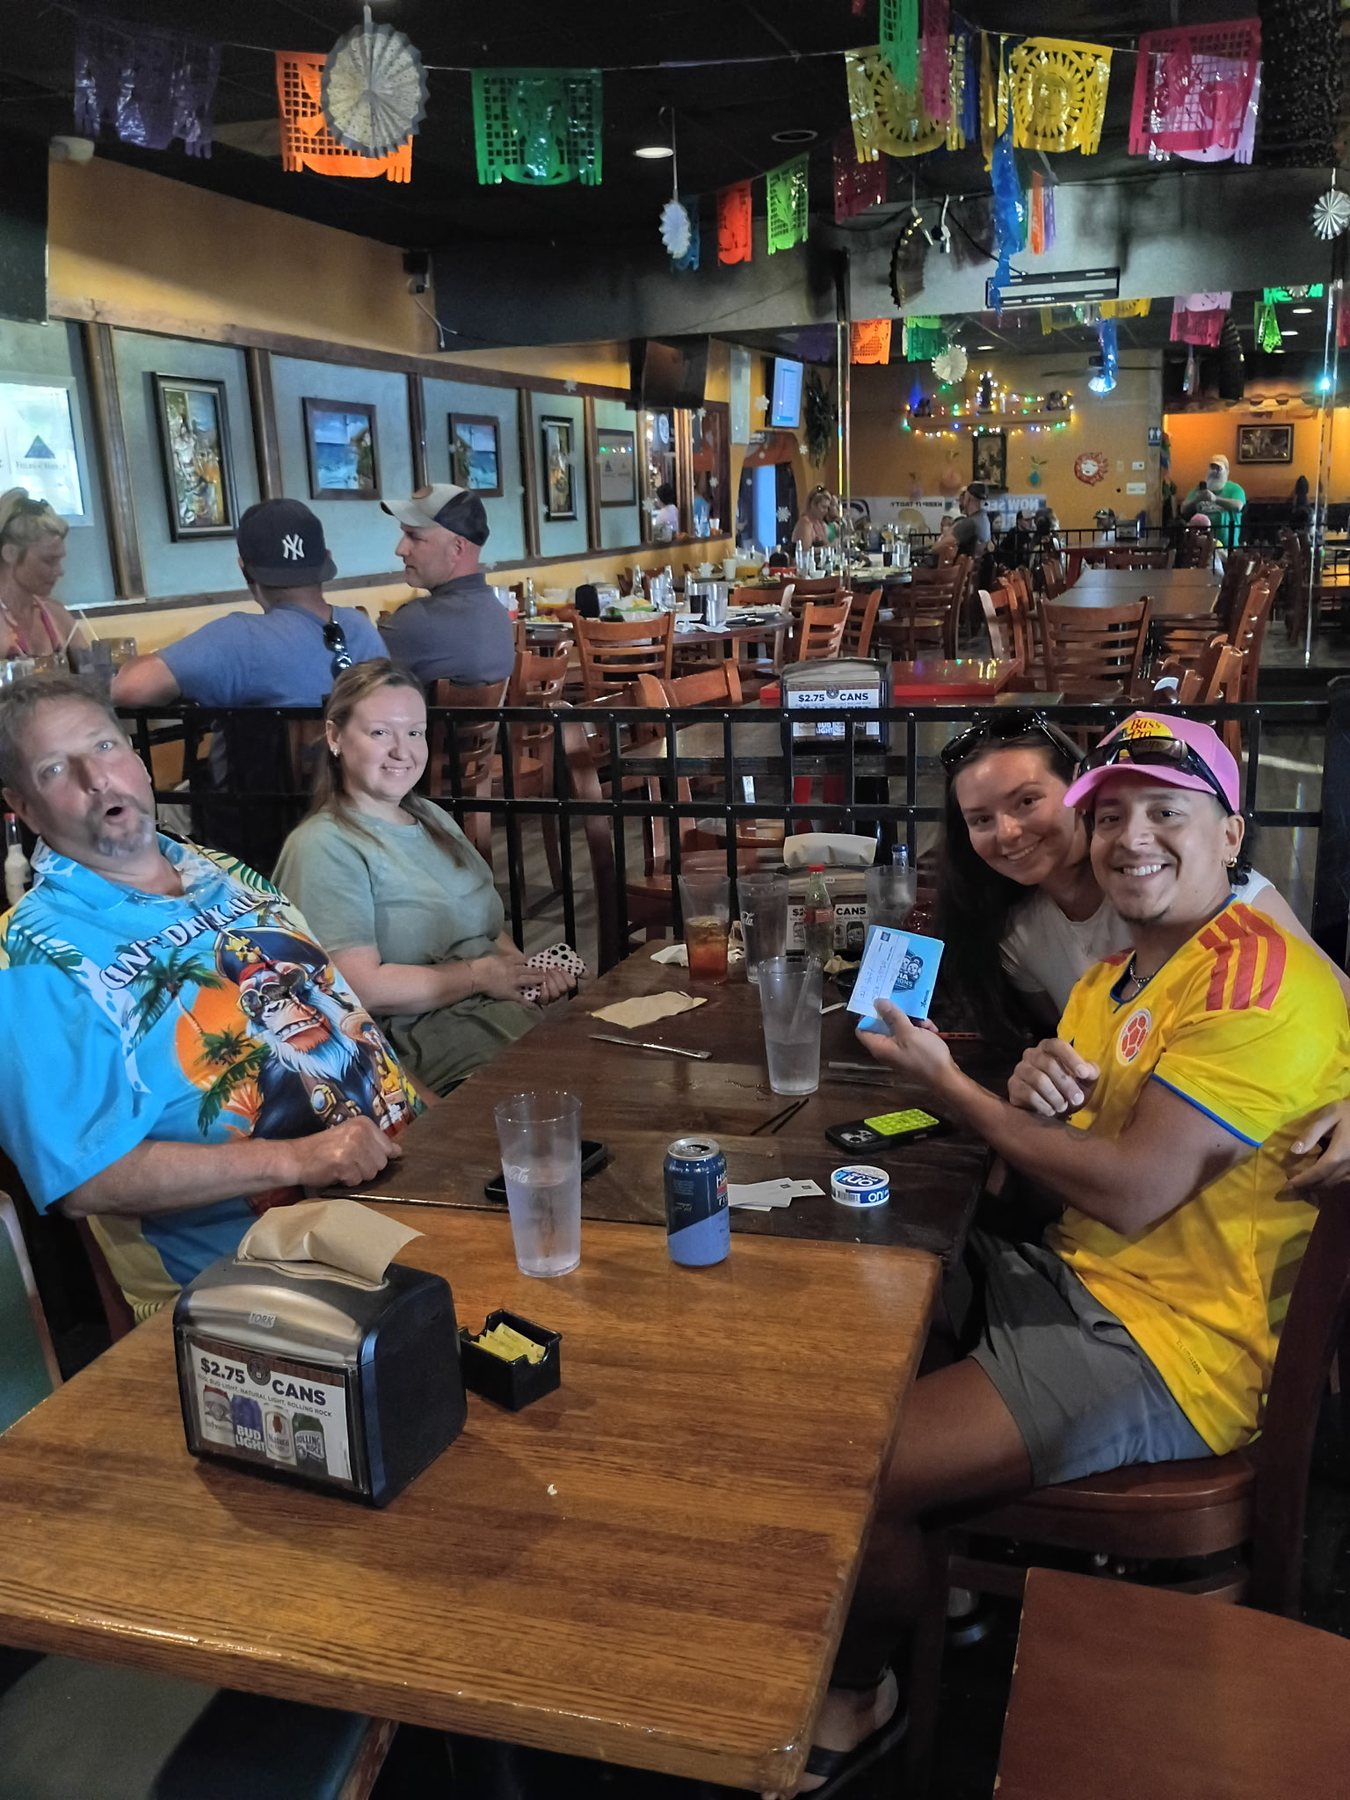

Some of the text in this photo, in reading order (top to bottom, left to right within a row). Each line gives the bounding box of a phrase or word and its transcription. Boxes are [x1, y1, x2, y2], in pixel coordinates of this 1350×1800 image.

[281, 533, 305, 560] NY
[798, 692, 869, 703] $2.75 CANS
[1131, 719, 1161, 730] Bass
[836, 907, 867, 916] CANS
[200, 1357, 327, 1406] $2.75 CANS
[287, 1401, 314, 1413] ROLLING
[314, 1409, 332, 1418] ROCK
[236, 1424, 262, 1441] BUD
[235, 1434, 266, 1452] LIGHT
